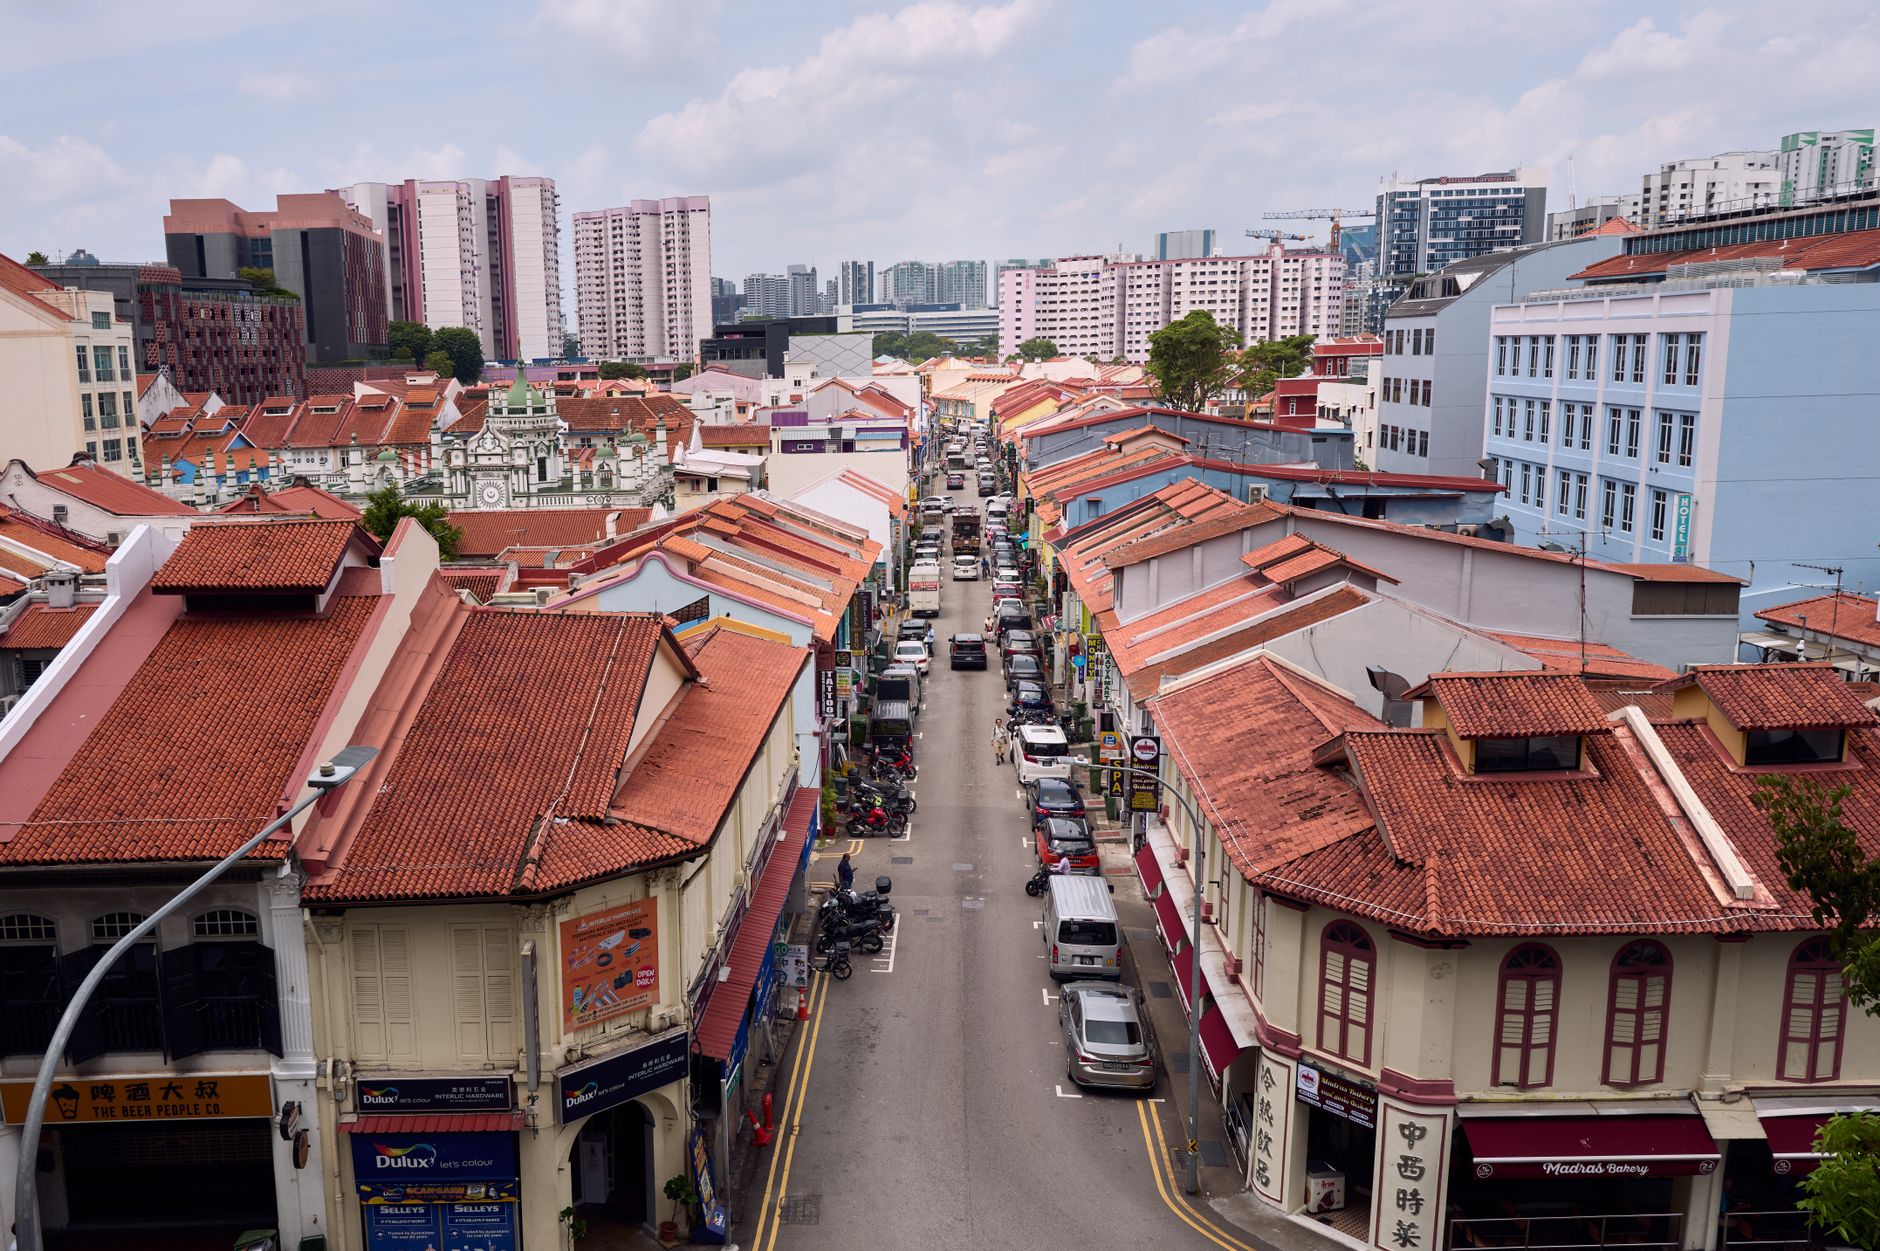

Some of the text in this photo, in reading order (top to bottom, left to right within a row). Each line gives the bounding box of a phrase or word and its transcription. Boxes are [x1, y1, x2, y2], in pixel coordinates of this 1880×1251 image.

[1679, 498, 1689, 542] HOTEL
[1088, 640, 1097, 679] MONEY
[826, 671, 834, 713] TATTOO
[1112, 760, 1122, 792] SPA
[775, 945, 788, 954] GO
[637, 969, 655, 978] OPEN
[636, 977, 655, 987] DAILY
[628, 1066, 654, 1081] INTERLIC
[654, 1055, 685, 1071] HARDWARE
[566, 1082, 626, 1108] Dulux let's colour
[1321, 1077, 1348, 1093] Madras
[1348, 1088, 1376, 1104] Bakery
[363, 1095, 395, 1104] Dulux
[92, 1103, 225, 1118] THE BEER PEOPLE CO.
[375, 1155, 494, 1169] Dulux let's colour
[1542, 1162, 1650, 1176] Madras Bakery
[1392, 1120, 1427, 1248] 中西時菜
[380, 1205, 425, 1214] SELLEYS
[454, 1204, 500, 1213] SELLEYS
